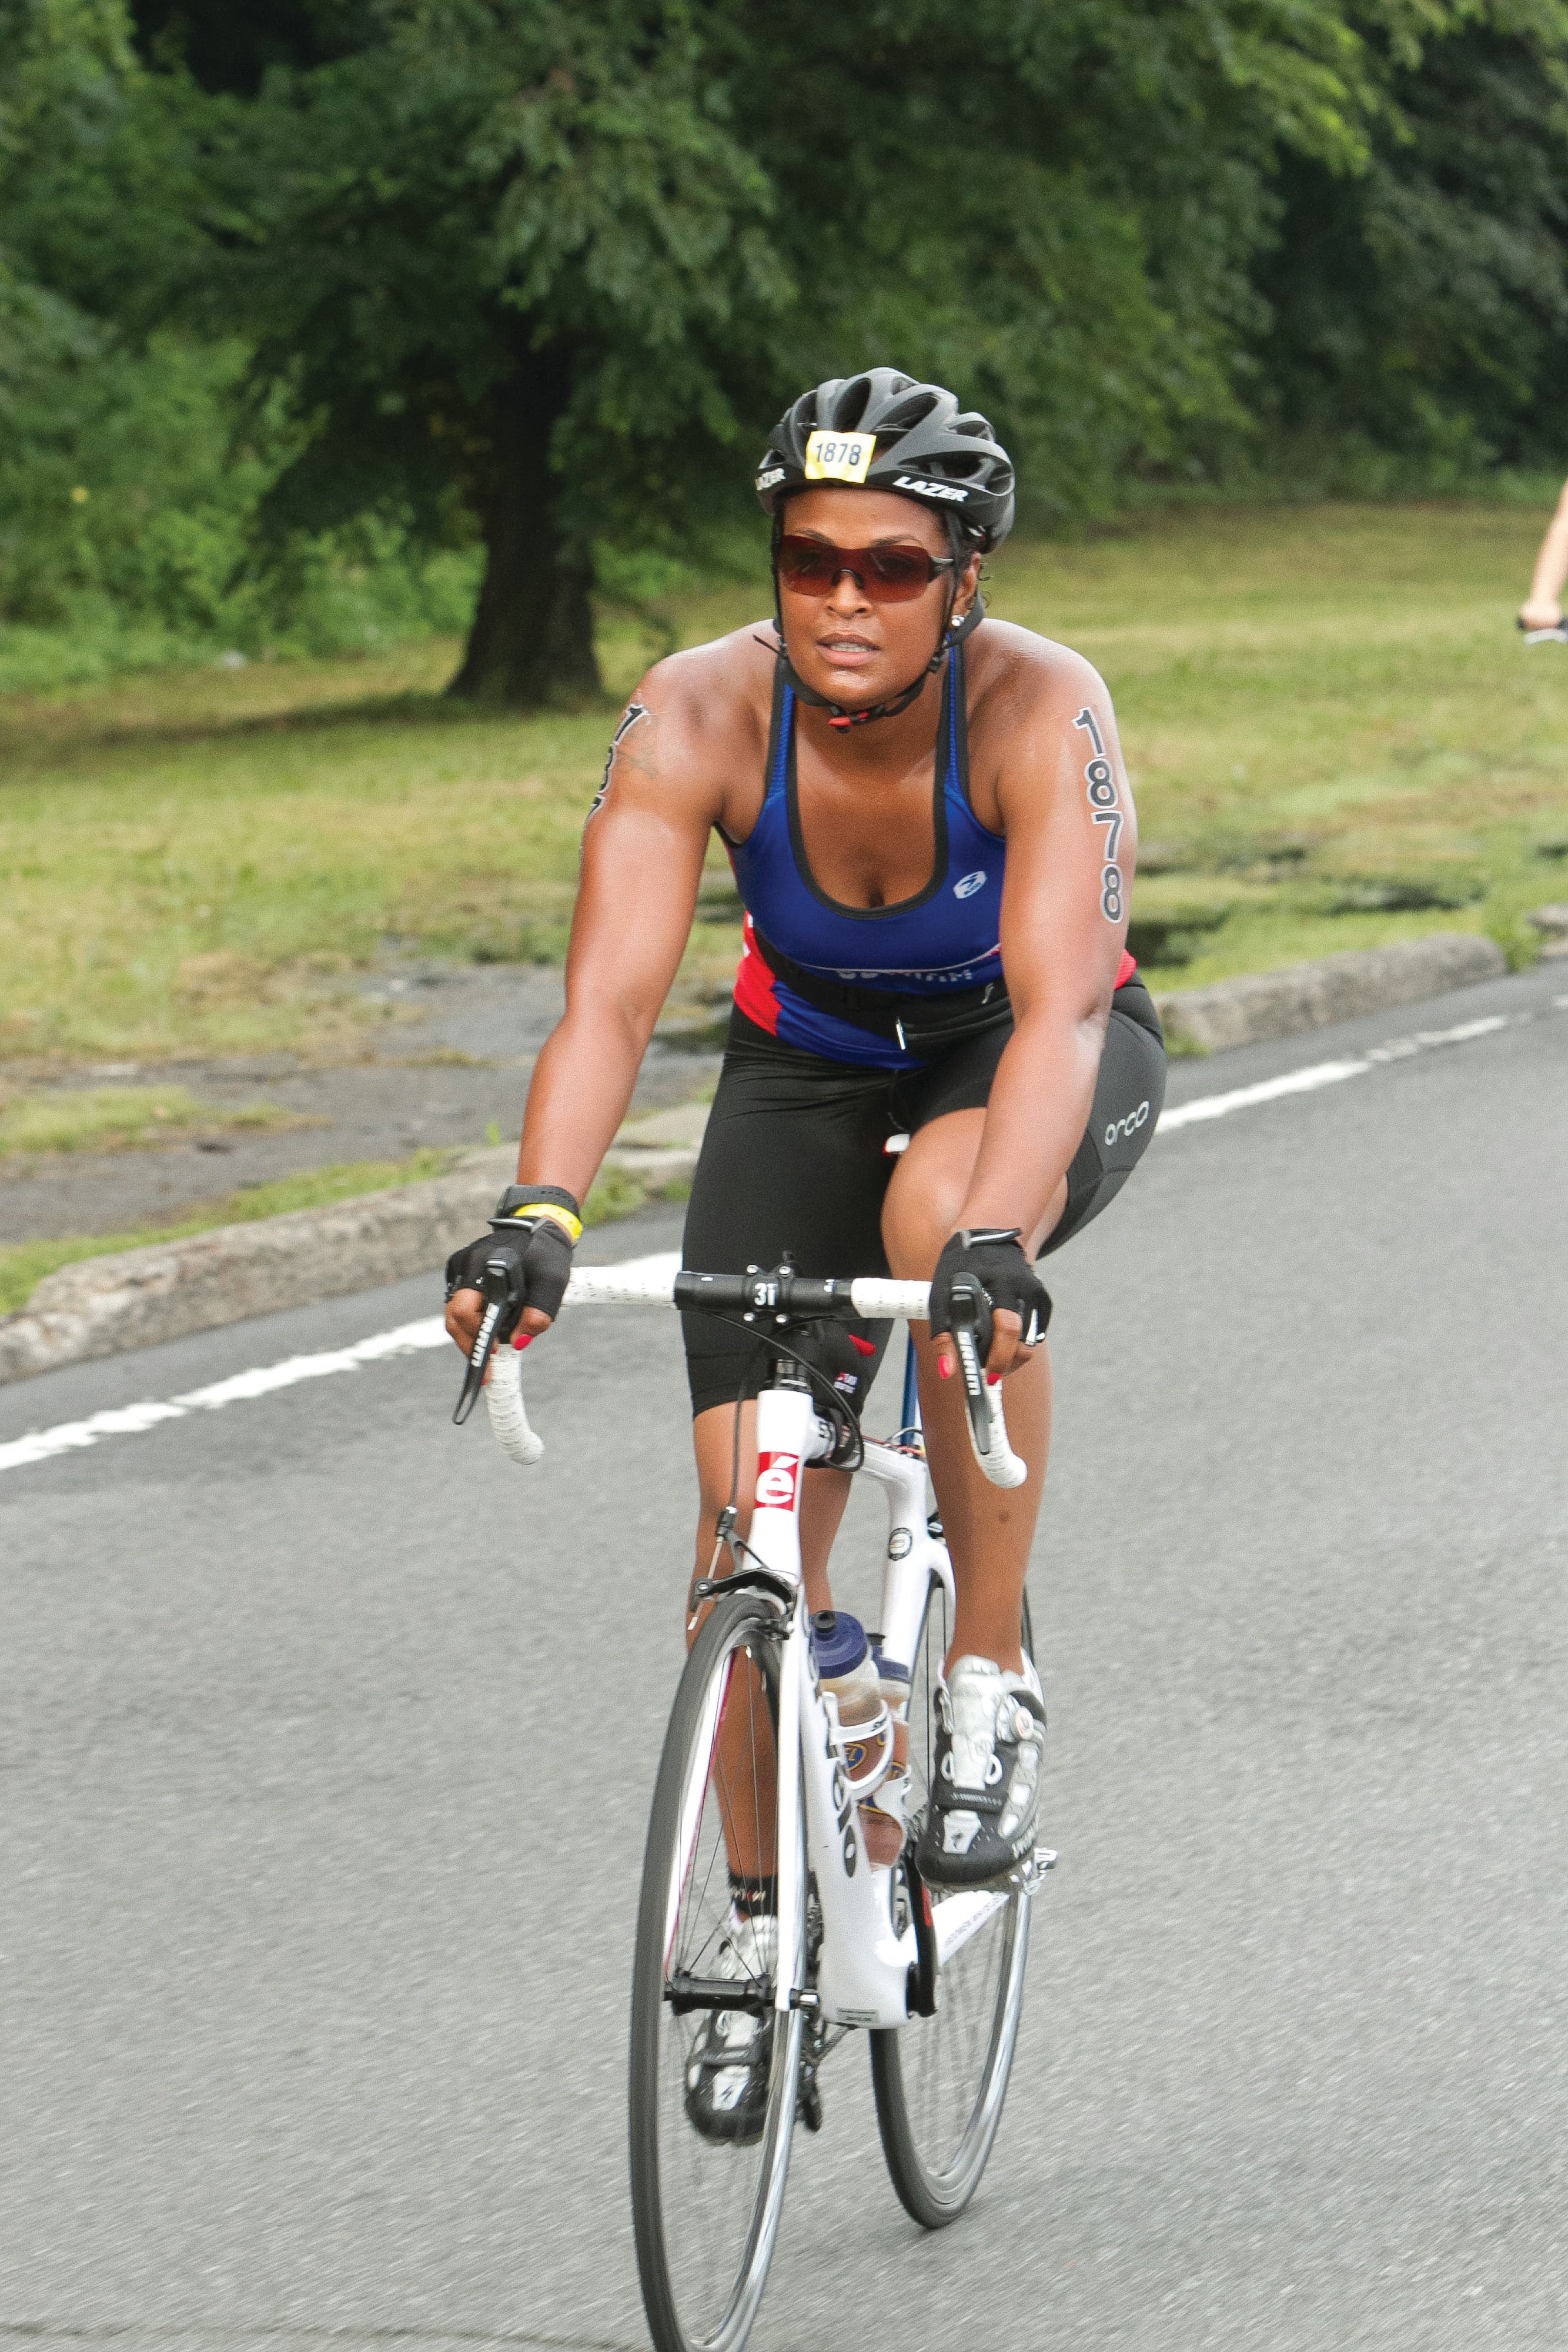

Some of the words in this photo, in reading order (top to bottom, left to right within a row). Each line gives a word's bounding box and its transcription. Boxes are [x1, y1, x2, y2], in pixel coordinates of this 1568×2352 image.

[816, 442, 862, 466] 1878
[892, 476, 969, 502] LAZER
[1071, 707, 1124, 924] 1878
